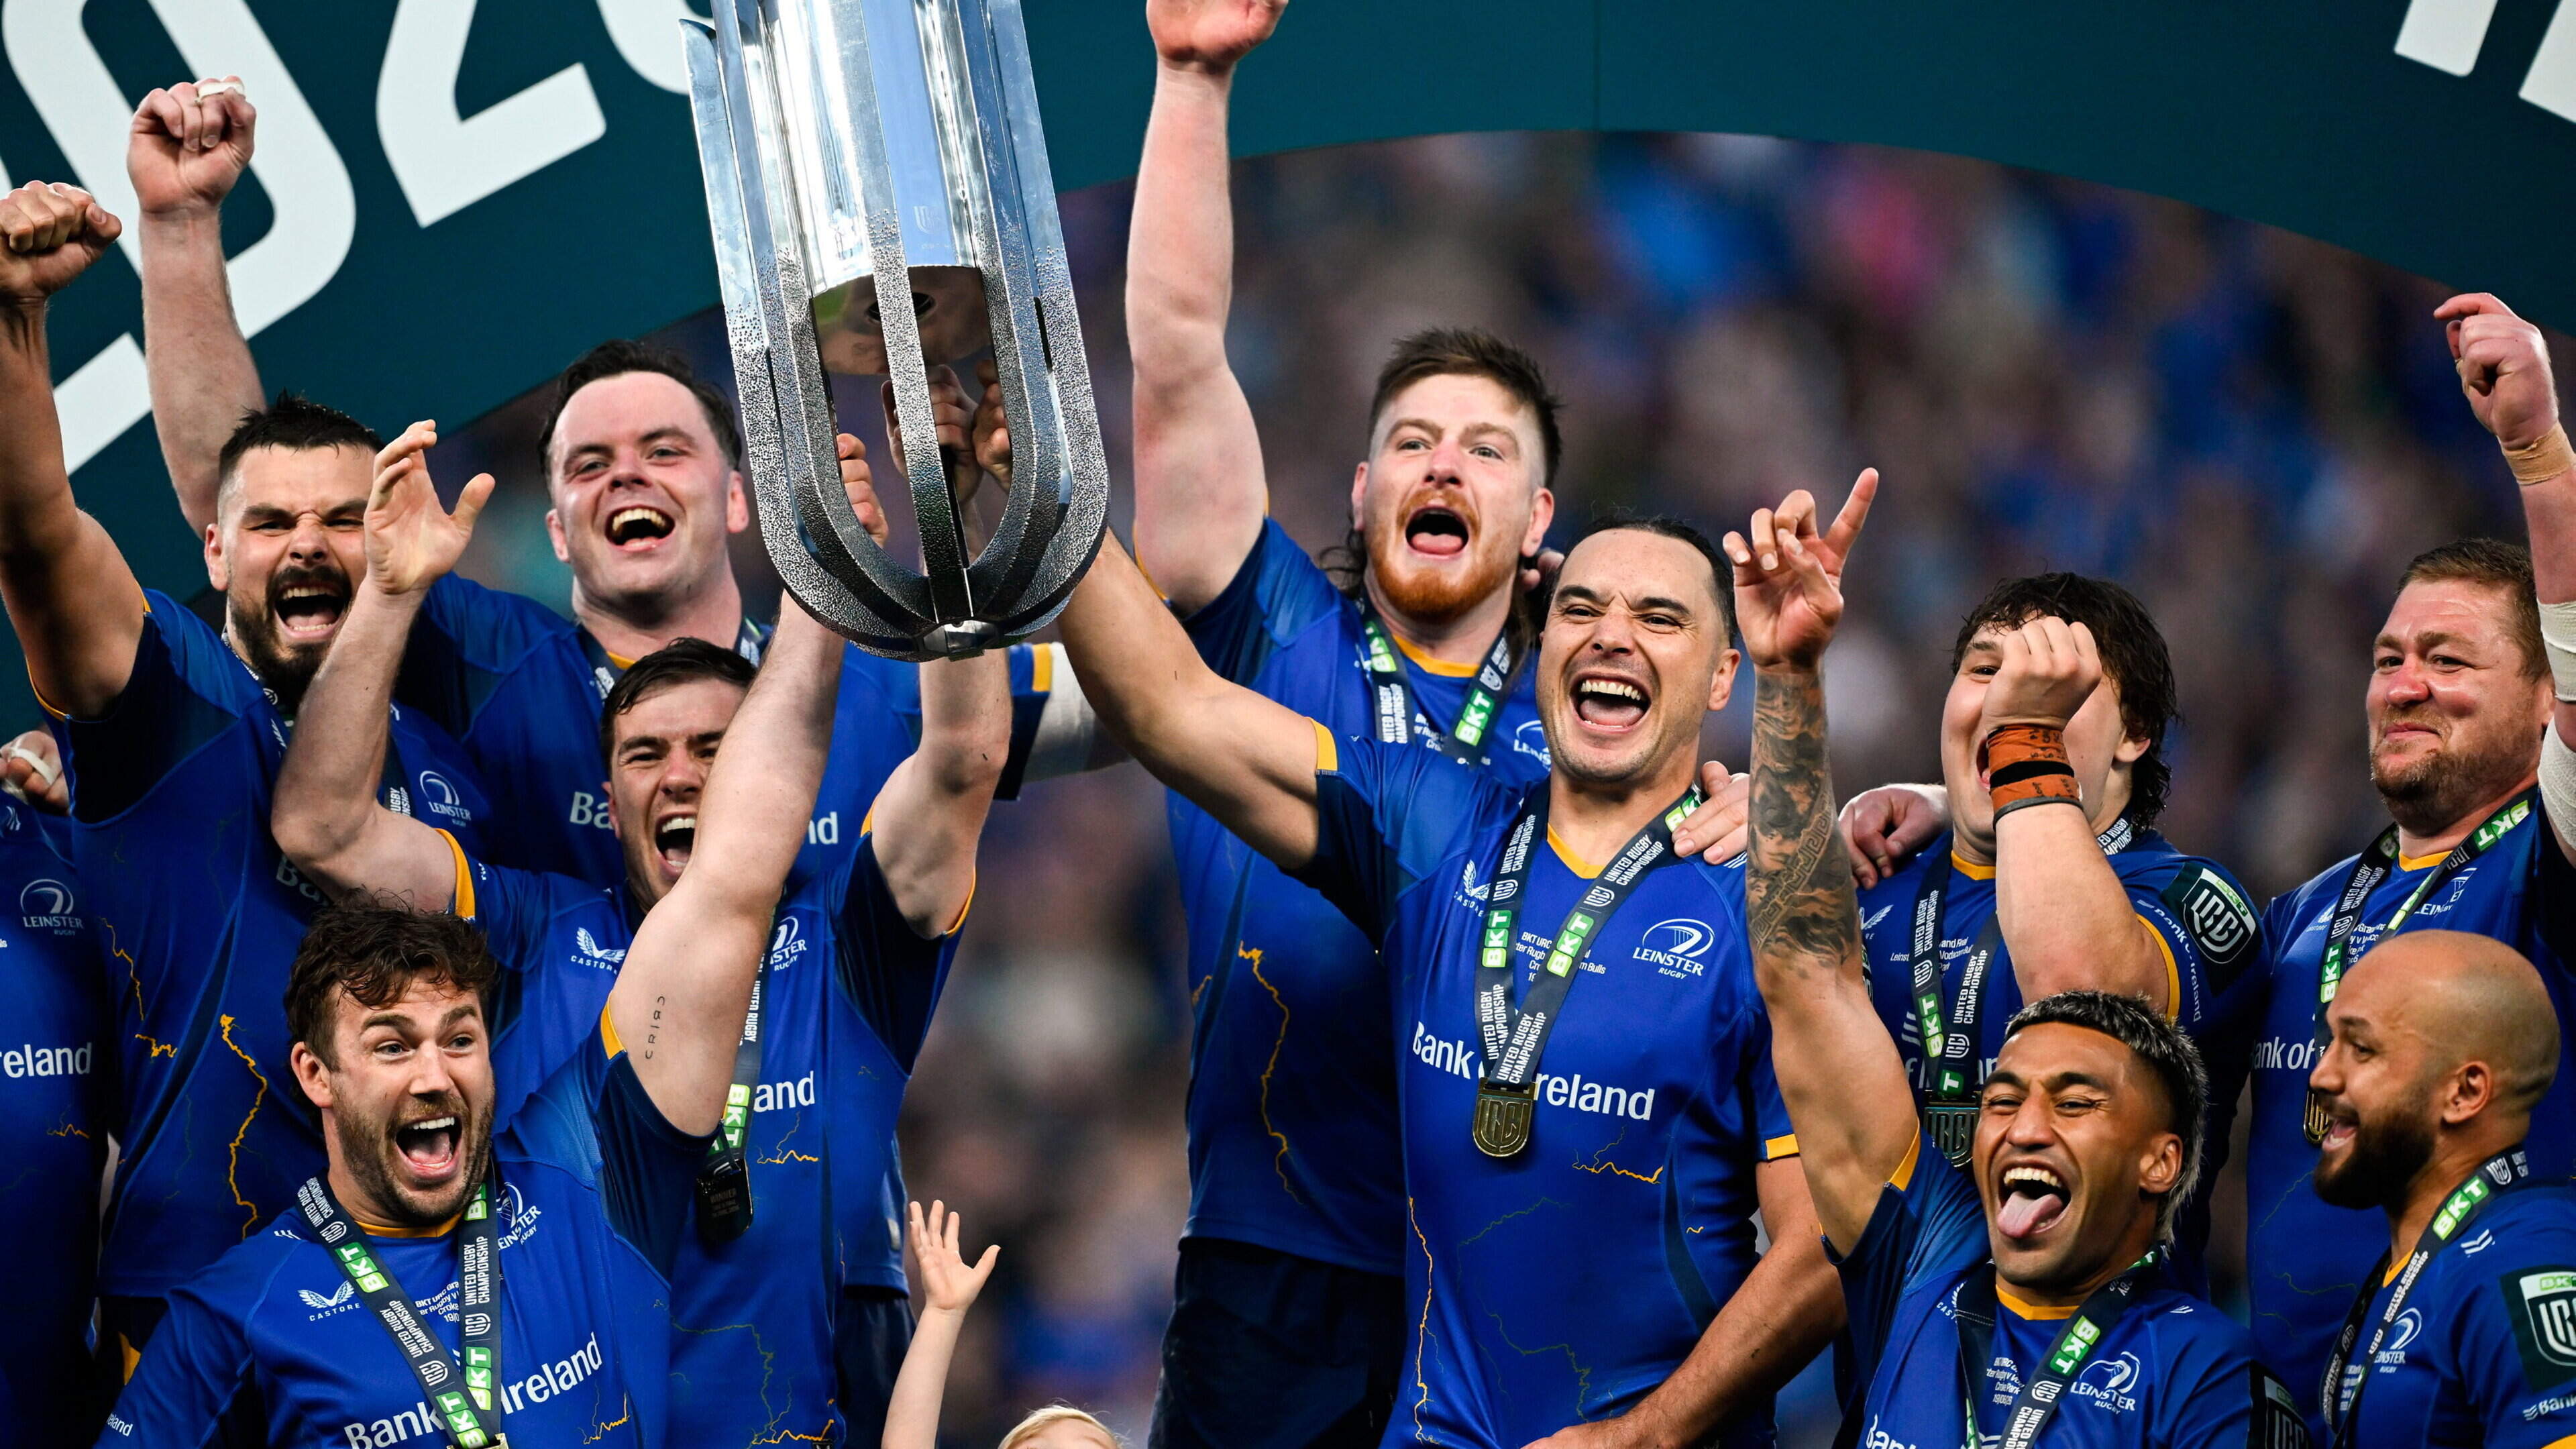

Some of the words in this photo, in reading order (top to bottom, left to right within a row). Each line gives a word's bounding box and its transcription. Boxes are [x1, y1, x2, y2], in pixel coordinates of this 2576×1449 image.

[1458, 691, 1492, 744] BKT
[1513, 739, 1552, 766] LEINS
[390, 787, 402, 814] UGBY
[428, 801, 472, 820] LEINSTER
[570, 792, 614, 830] Ba
[2106, 818, 2129, 839] RUGBY
[2477, 800, 2530, 848] BKT
[1499, 845, 1517, 874] UNITED
[1510, 822, 1525, 847] RUGBY
[1511, 814, 1536, 872] CHAMPIONSHIP
[1604, 856, 1633, 883] UNITED
[1626, 834, 1653, 861] RUGBY
[1615, 841, 1665, 886] CHAMPIONSHIP
[2339, 886, 2361, 913] UNITED
[2356, 863, 2374, 888] RUGBY
[2350, 866, 2387, 910] CHAMPIONSHIP
[22, 916, 84, 928] LEINSTER
[1916, 898, 1929, 926] RUGBY
[1923, 889, 1940, 953] CHAMPIONSHIP
[1485, 911, 1509, 966] BKT
[1521, 931, 1537, 944] BKT
[1536, 936, 1553, 950] URC
[1526, 945, 1546, 961] Rugb
[1550, 914, 1590, 974] BKT
[1890, 952, 1910, 962] Leinst
[1914, 924, 1926, 958] UNITED
[1587, 963, 1607, 975] Bulls
[1632, 947, 1705, 977] LEINSTER
[1658, 967, 1688, 980] RUGBY
[2322, 945, 2341, 1002] BKT
[1953, 989, 1969, 1024] UNITED
[1962, 955, 1978, 988] RUGBY
[1964, 949, 1988, 1025] CHAMPIONSHIP
[2190, 962, 2203, 1023] Ireland
[1481, 991, 1494, 1022] RUGBY
[743, 1012, 759, 1042] RUGBY
[1483, 1024, 1500, 1061] UNITED
[1921, 996, 1943, 1057] BKT
[0, 1041, 92, 1078] eland
[1496, 1046, 1520, 1081] UNITED
[1511, 1013, 1534, 1046] RUGBY
[1508, 1011, 1547, 1084] CHAMPIONSHIP
[2288, 1038, 2316, 1070] of
[725, 1085, 746, 1147] BKT
[1534, 1073, 1656, 1122] reland
[303, 1201, 325, 1228] UNITED
[2437, 1177, 2484, 1238] BKT
[498, 1205, 542, 1252] EINSTER
[520, 1224, 537, 1246] RUGBY
[339, 1245, 384, 1291] BKT
[463, 1244, 476, 1273] RUGBY
[476, 1235, 490, 1304] CHAMPIONSHIP
[415, 1295, 433, 1309] BKT
[446, 1281, 460, 1291] Gra
[429, 1295, 452, 1313] Rugby
[465, 1273, 477, 1306] UNITED
[2383, 1284, 2404, 1322] UNITED
[2400, 1250, 2421, 1286] RUGBY
[2385, 1250, 2429, 1323] CHAMPIONSHIP
[309, 1301, 361, 1322] CASTORE
[379, 1307, 404, 1332] RUGBY
[388, 1299, 435, 1354] CHAMPIONSHIP
[443, 1311, 460, 1324] 19/0
[397, 1329, 424, 1358] UNITED
[2053, 1319, 2098, 1375] BKT
[469, 1348, 489, 1410] BKT
[2379, 1366, 2398, 1374] RUGBY
[2070, 1381, 2136, 1411] LEINSTER
[2094, 1399, 2121, 1415] RUGBY
[439, 1394, 486, 1448] BKT
[2021, 1408, 2045, 1440] UNITED
